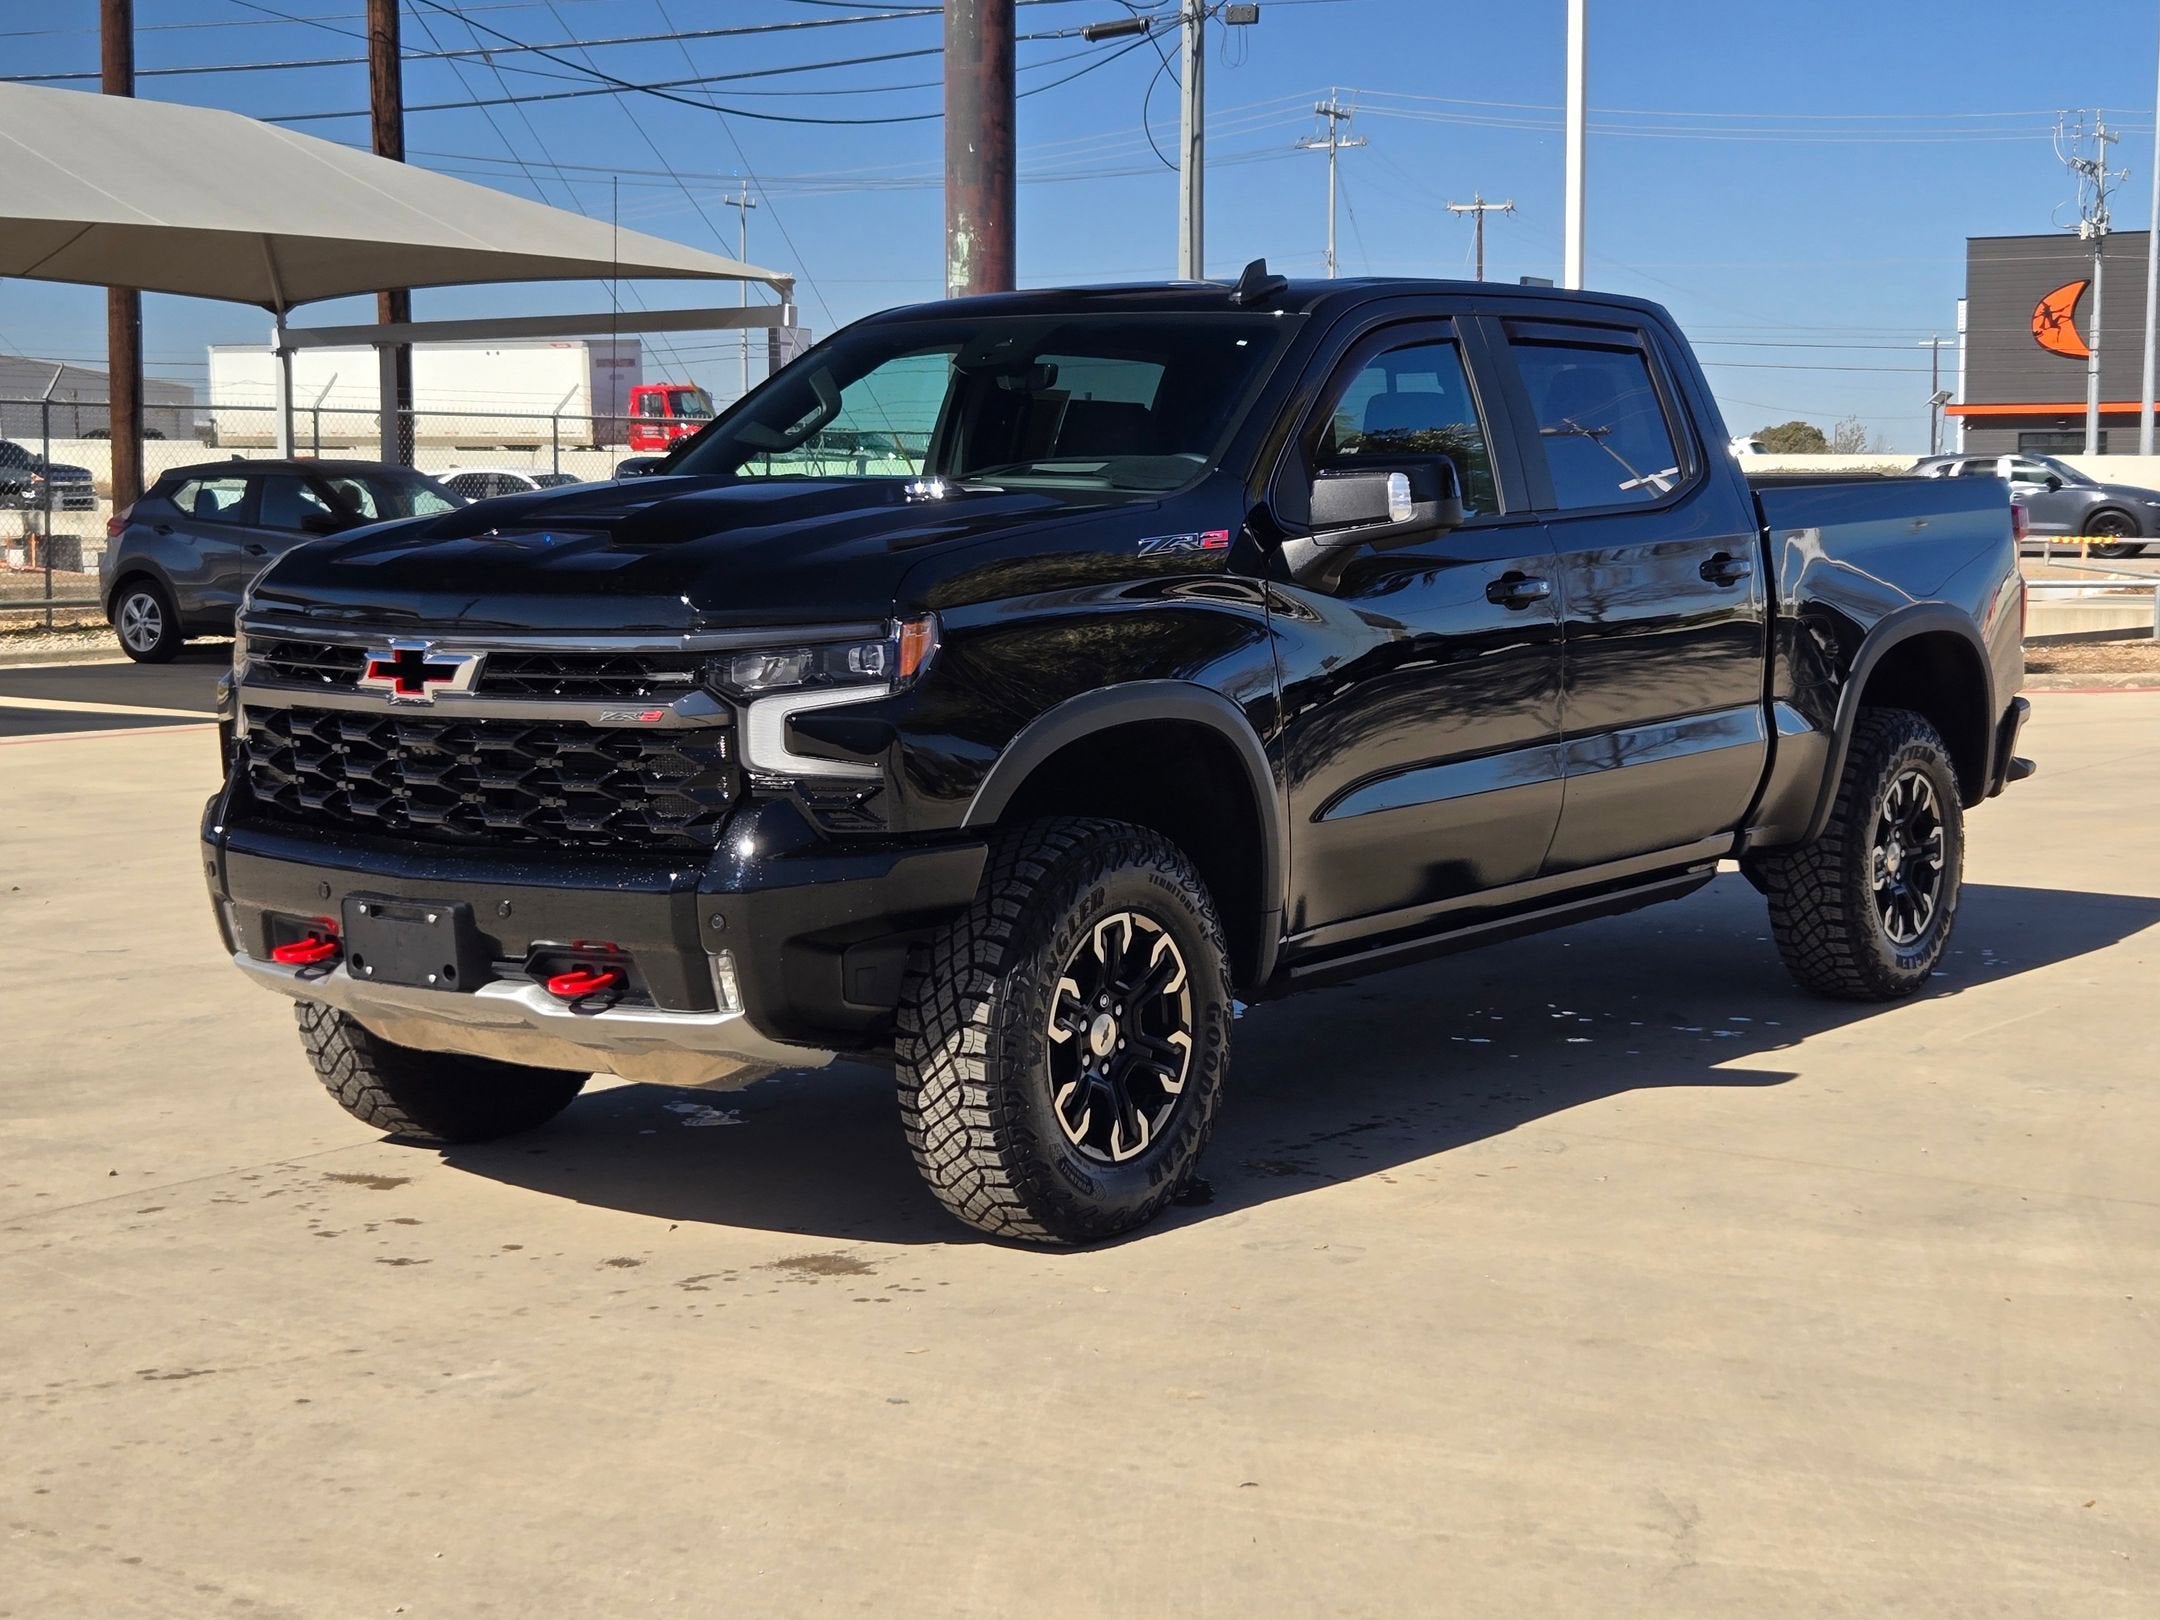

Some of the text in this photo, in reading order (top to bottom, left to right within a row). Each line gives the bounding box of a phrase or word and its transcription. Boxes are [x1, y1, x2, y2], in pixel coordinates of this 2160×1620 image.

[1138, 530, 1229, 558] ZR2
[599, 709, 665, 722] ZR2
[1149, 873, 1195, 914] TERRITORY
[1030, 886, 1106, 1066] WRANGLER
[1146, 1002, 1222, 1187] GOODYEAR
